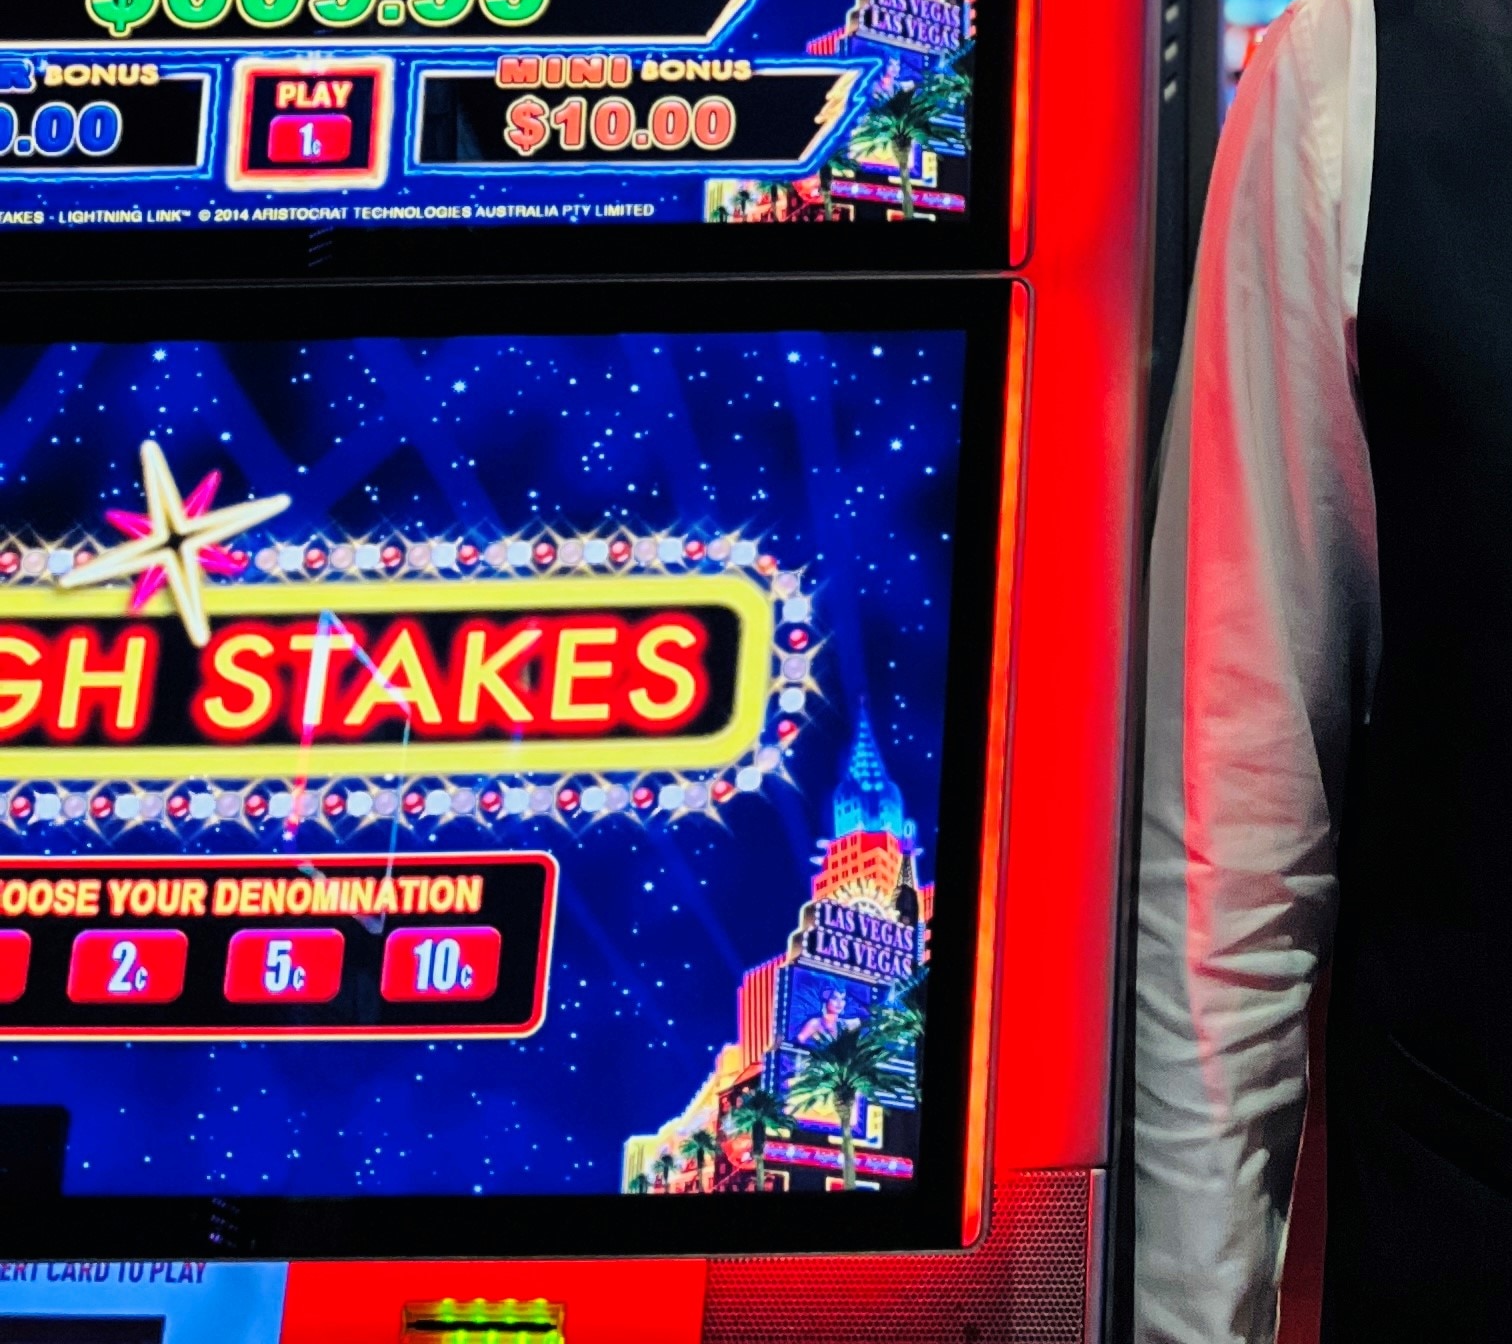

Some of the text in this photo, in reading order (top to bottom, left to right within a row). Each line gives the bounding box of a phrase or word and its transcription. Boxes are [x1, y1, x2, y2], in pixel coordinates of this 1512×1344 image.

[872, 9, 960, 51] LAS VEGAS
[44, 64, 159, 86] BONUS
[496, 55, 752, 88] MINI BONUS
[276, 81, 353, 109] PLAY
[503, 95, 736, 156] $10.00
[58, 210, 143, 223] LIGHTNING
[213, 209, 249, 222] 2014
[252, 207, 348, 221] ARISTOCRAT
[353, 206, 472, 220] TECHNOLOGIES
[475, 205, 559, 218] AUSTRALIA
[562, 205, 591, 217] PTY
[595, 204, 655, 217] LIMITED
[204, 624, 697, 729] STAKES
[106, 878, 208, 917] YOUR
[212, 876, 484, 916] DENOMINATION
[825, 903, 914, 952] LAS VEGAS
[816, 930, 912, 976] LAS VEGAS
[149, 1261, 207, 1284] PLAY
